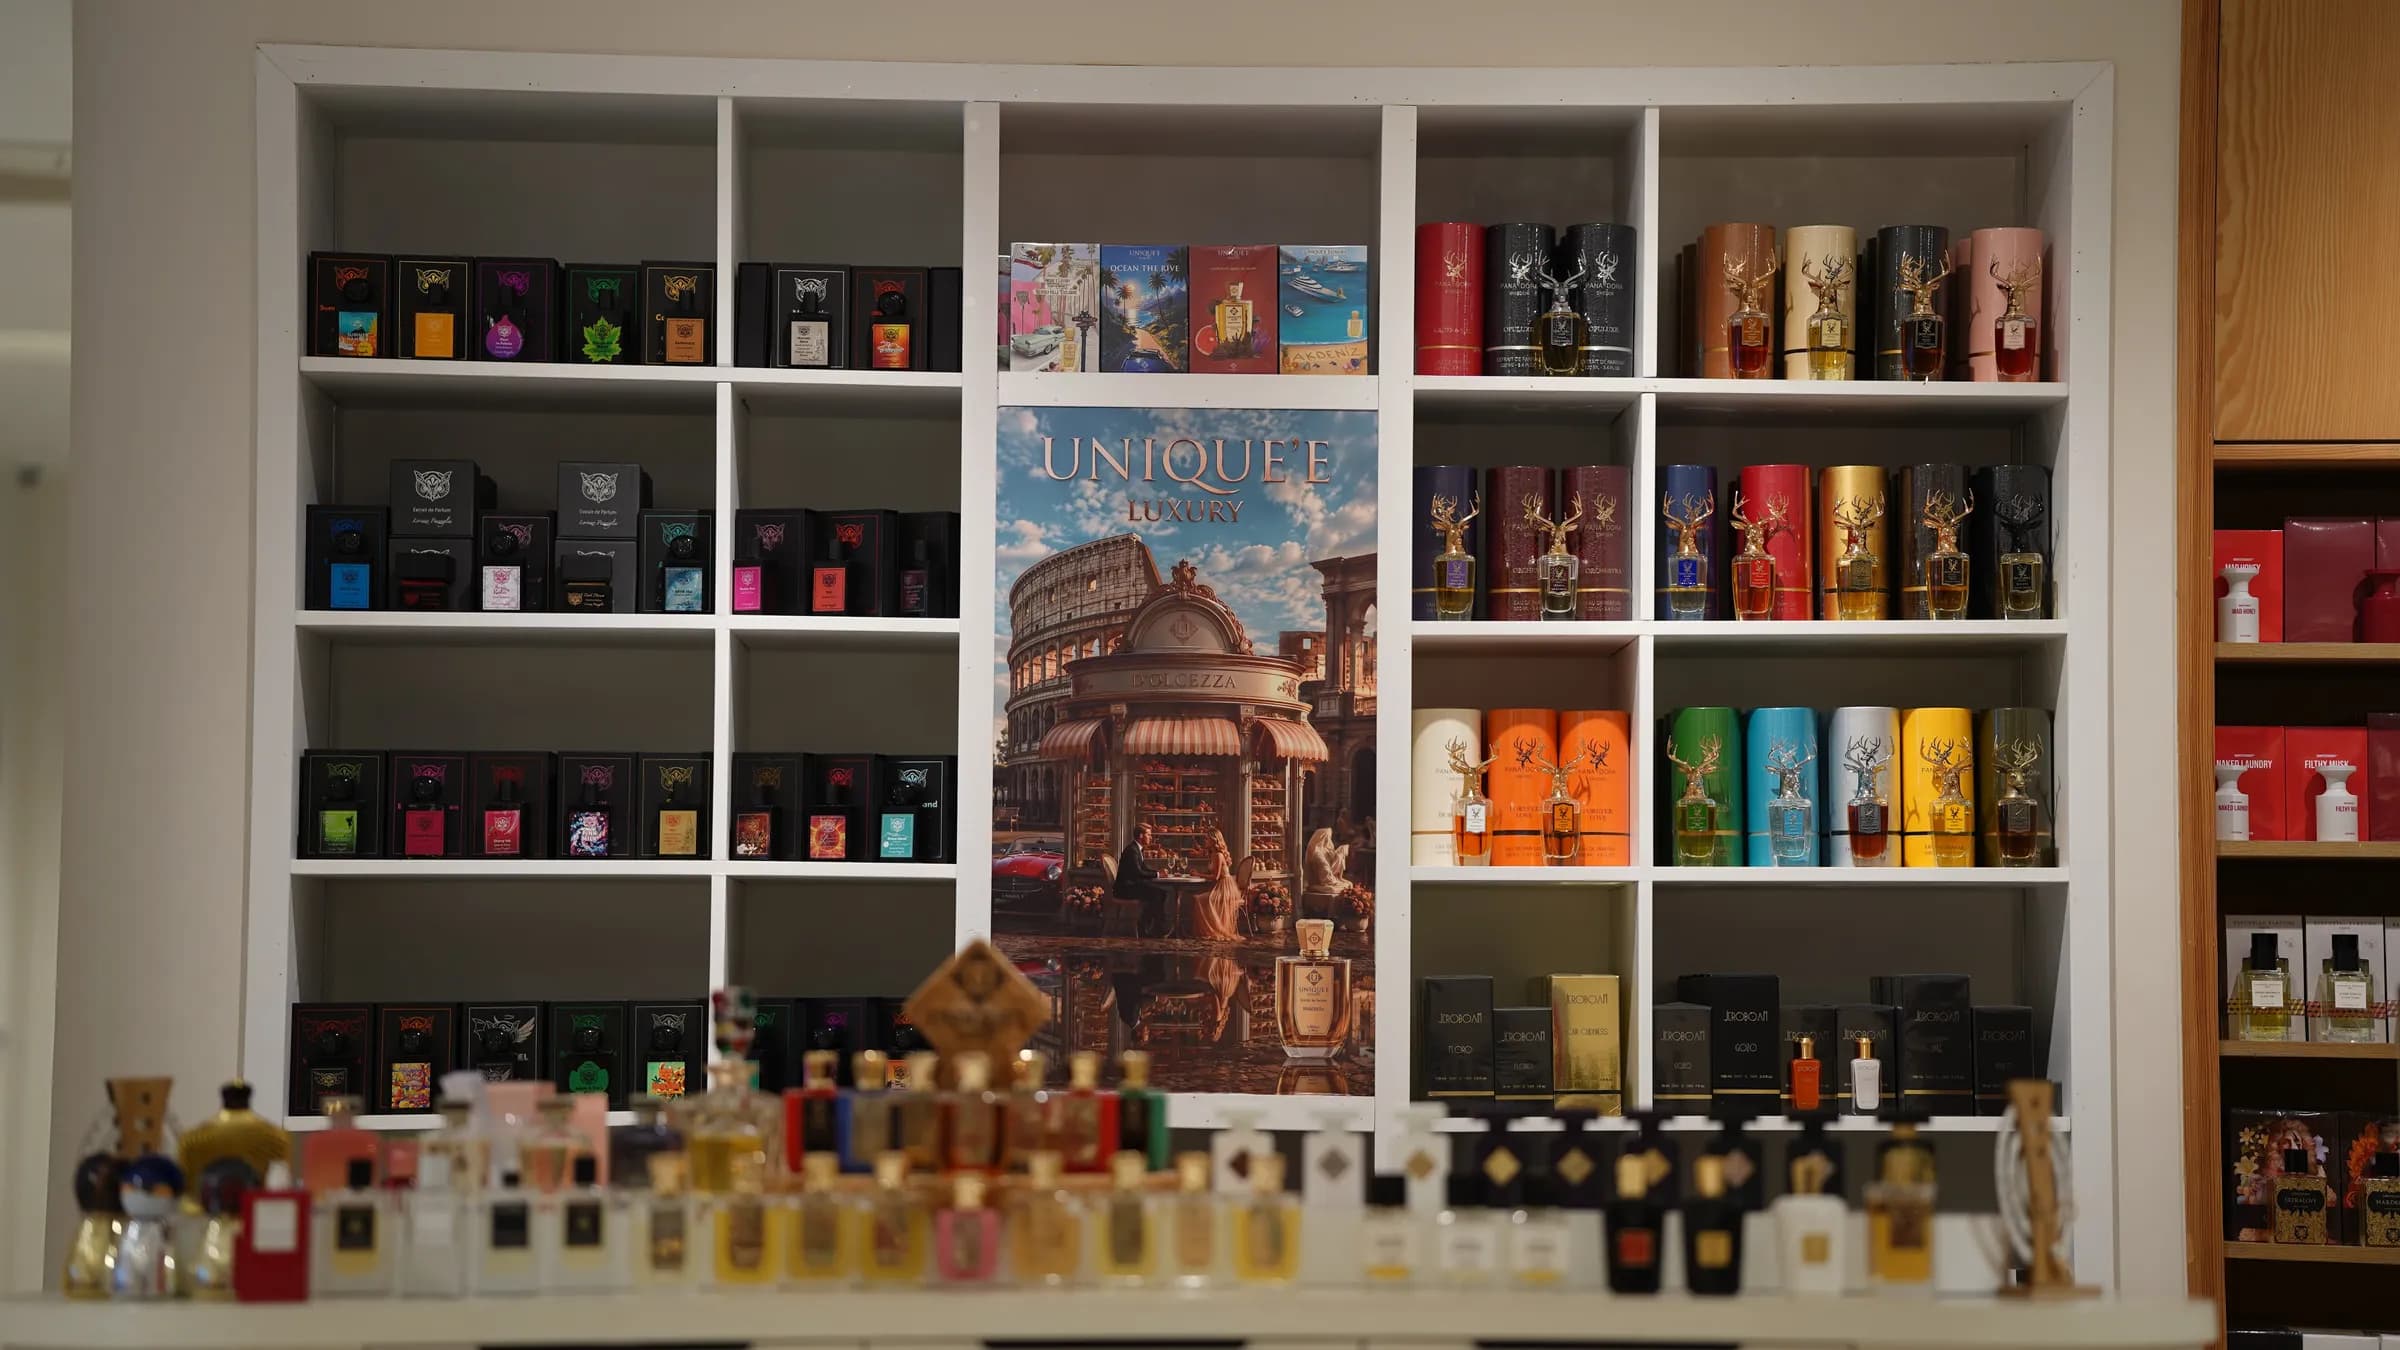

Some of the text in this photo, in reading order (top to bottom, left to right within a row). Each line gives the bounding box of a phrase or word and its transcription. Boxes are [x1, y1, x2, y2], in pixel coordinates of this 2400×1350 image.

[1110, 264, 1139, 272] OCEAN
[1042, 436, 1330, 494] UNIQUE'E
[1128, 500, 1244, 522] LUXURY
[1437, 1012, 1483, 1024] JEROBOAM
[1723, 1010, 1768, 1022] JEROBOAM
[1502, 1031, 1546, 1042] JEROBOAM
[1660, 1031, 1705, 1042] JEROBOAM
